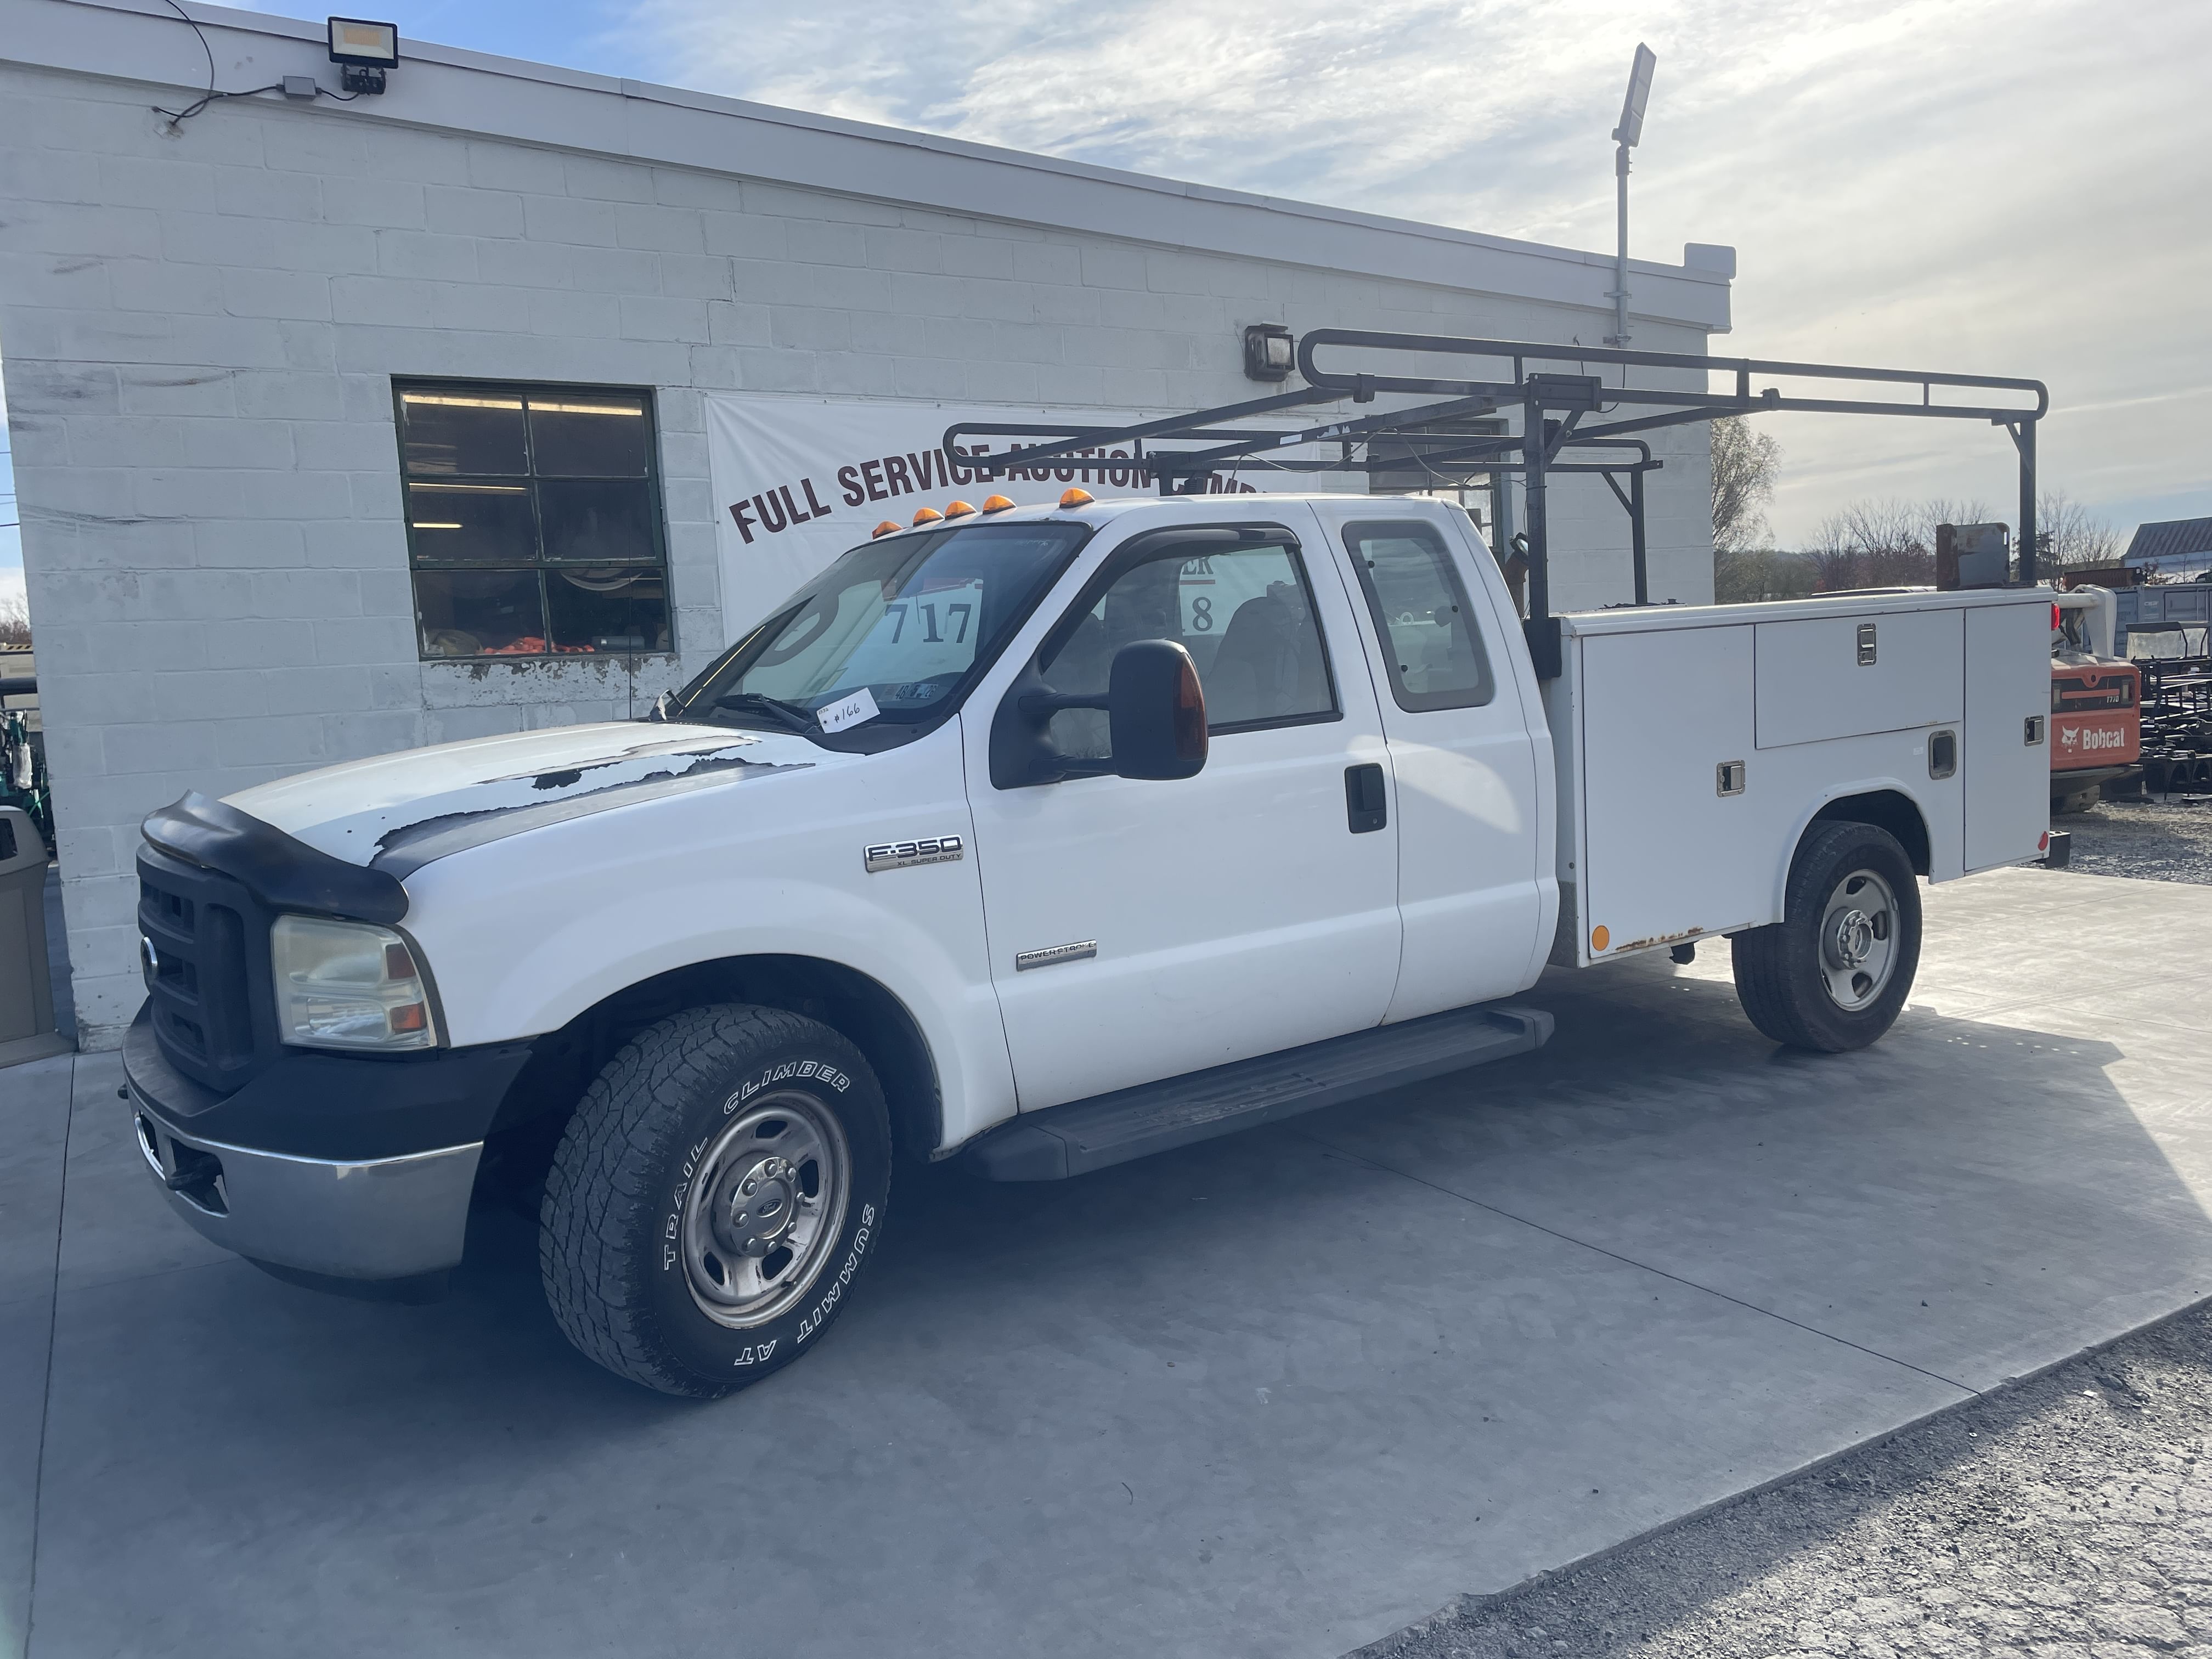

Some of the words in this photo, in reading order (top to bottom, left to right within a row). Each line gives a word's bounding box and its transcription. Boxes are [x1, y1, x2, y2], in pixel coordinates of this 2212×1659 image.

[729, 478, 832, 544] FULL
[837, 444, 994, 507] SERVICE
[834, 703, 860, 723] #166
[2083, 727, 2125, 750] Bobcat
[868, 837, 962, 862] F-350
[664, 1137, 709, 1271] TRAIL
[723, 1060, 850, 1115] CLIMBER
[797, 1203, 874, 1344] SUMMIT
[733, 1339, 777, 1367] AT
